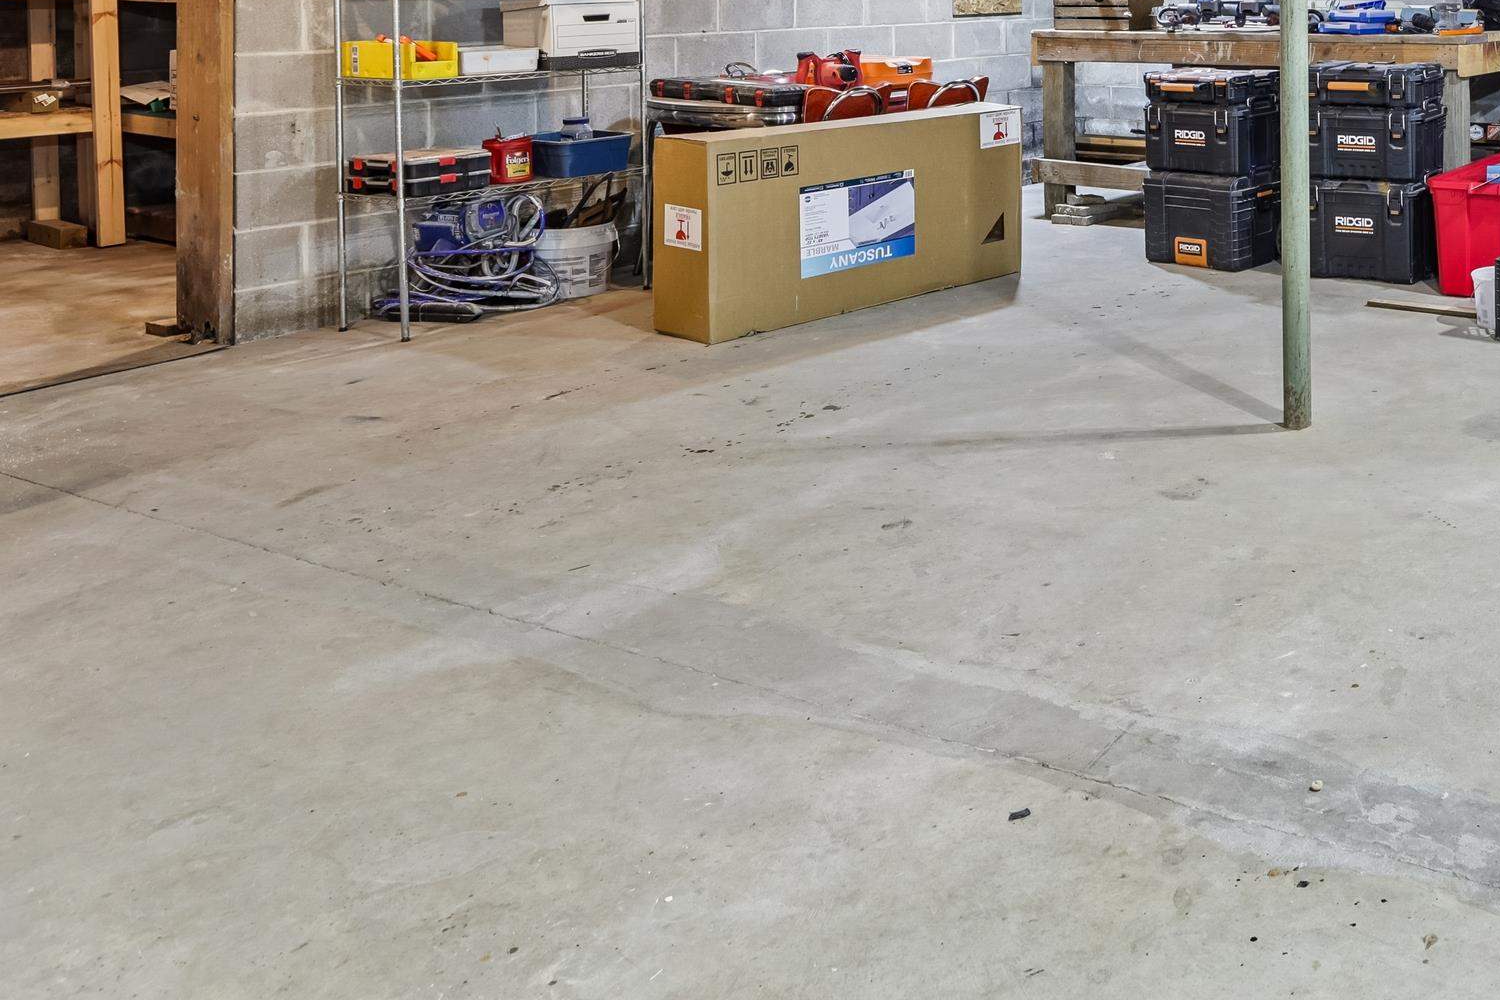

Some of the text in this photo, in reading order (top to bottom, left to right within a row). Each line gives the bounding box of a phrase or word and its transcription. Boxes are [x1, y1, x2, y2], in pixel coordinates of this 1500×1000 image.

[1174, 129, 1206, 140] RIDGID
[1337, 134, 1376, 146] RIDGID
[1334, 215, 1374, 228] RIDGID
[805, 243, 840, 258] MARBLE
[1178, 243, 1201, 252] RIDGID
[829, 245, 893, 270] TUSCANY
